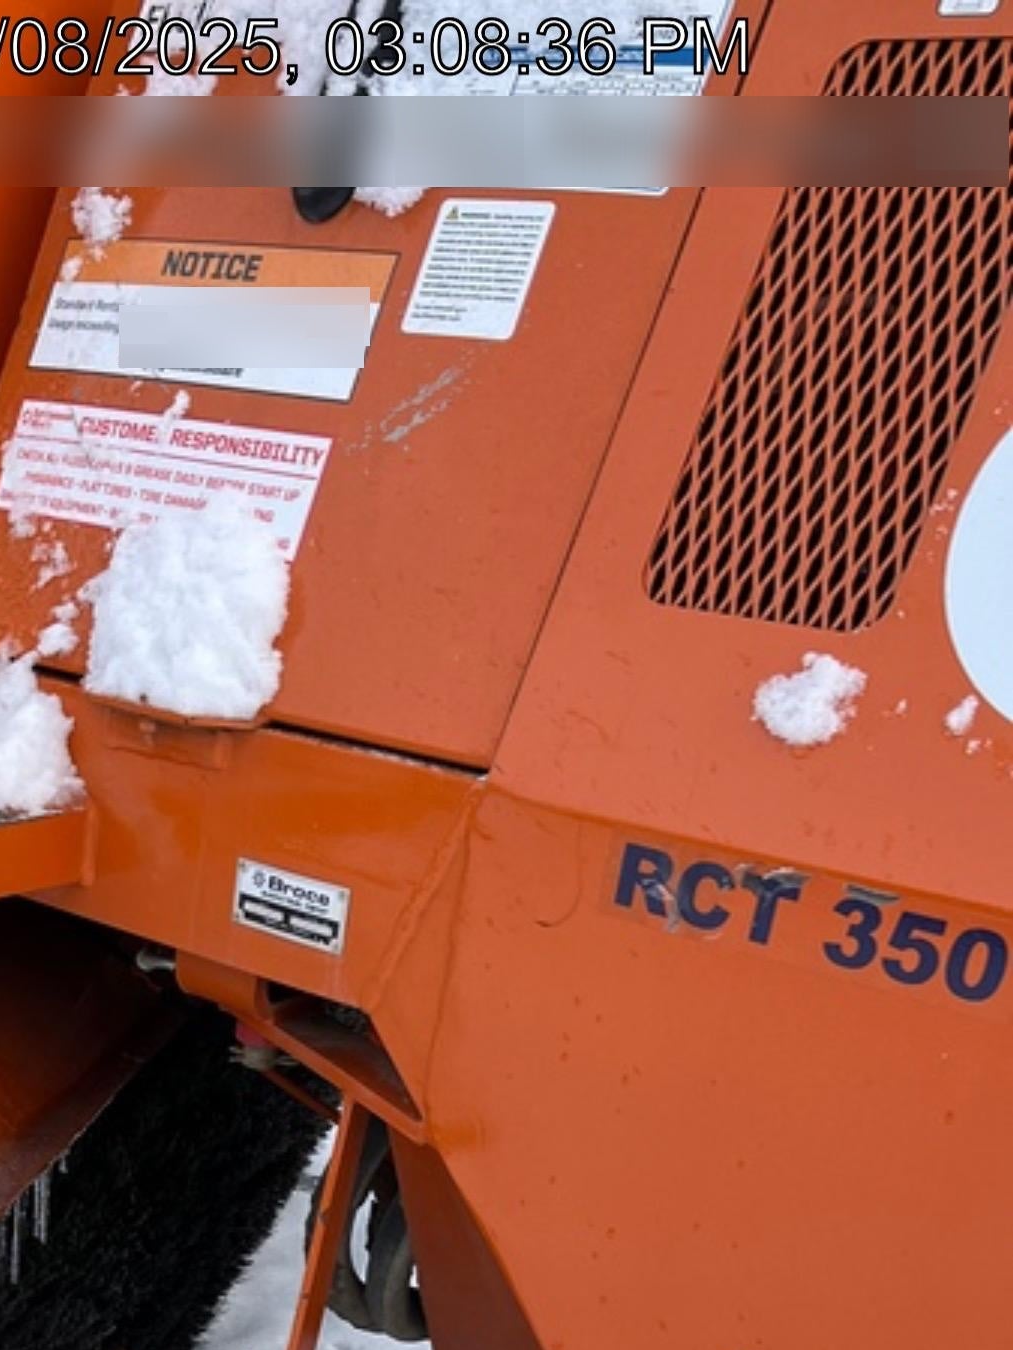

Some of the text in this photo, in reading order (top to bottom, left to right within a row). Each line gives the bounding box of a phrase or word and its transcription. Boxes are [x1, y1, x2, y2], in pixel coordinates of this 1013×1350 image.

[161, 250, 263, 281] NOTICE
[80, 416, 159, 444] CUSTOME
[170, 428, 324, 466] RESPONSIBILITY
[268, 875, 330, 906] Broce
[614, 842, 1008, 1002] RCT 350
